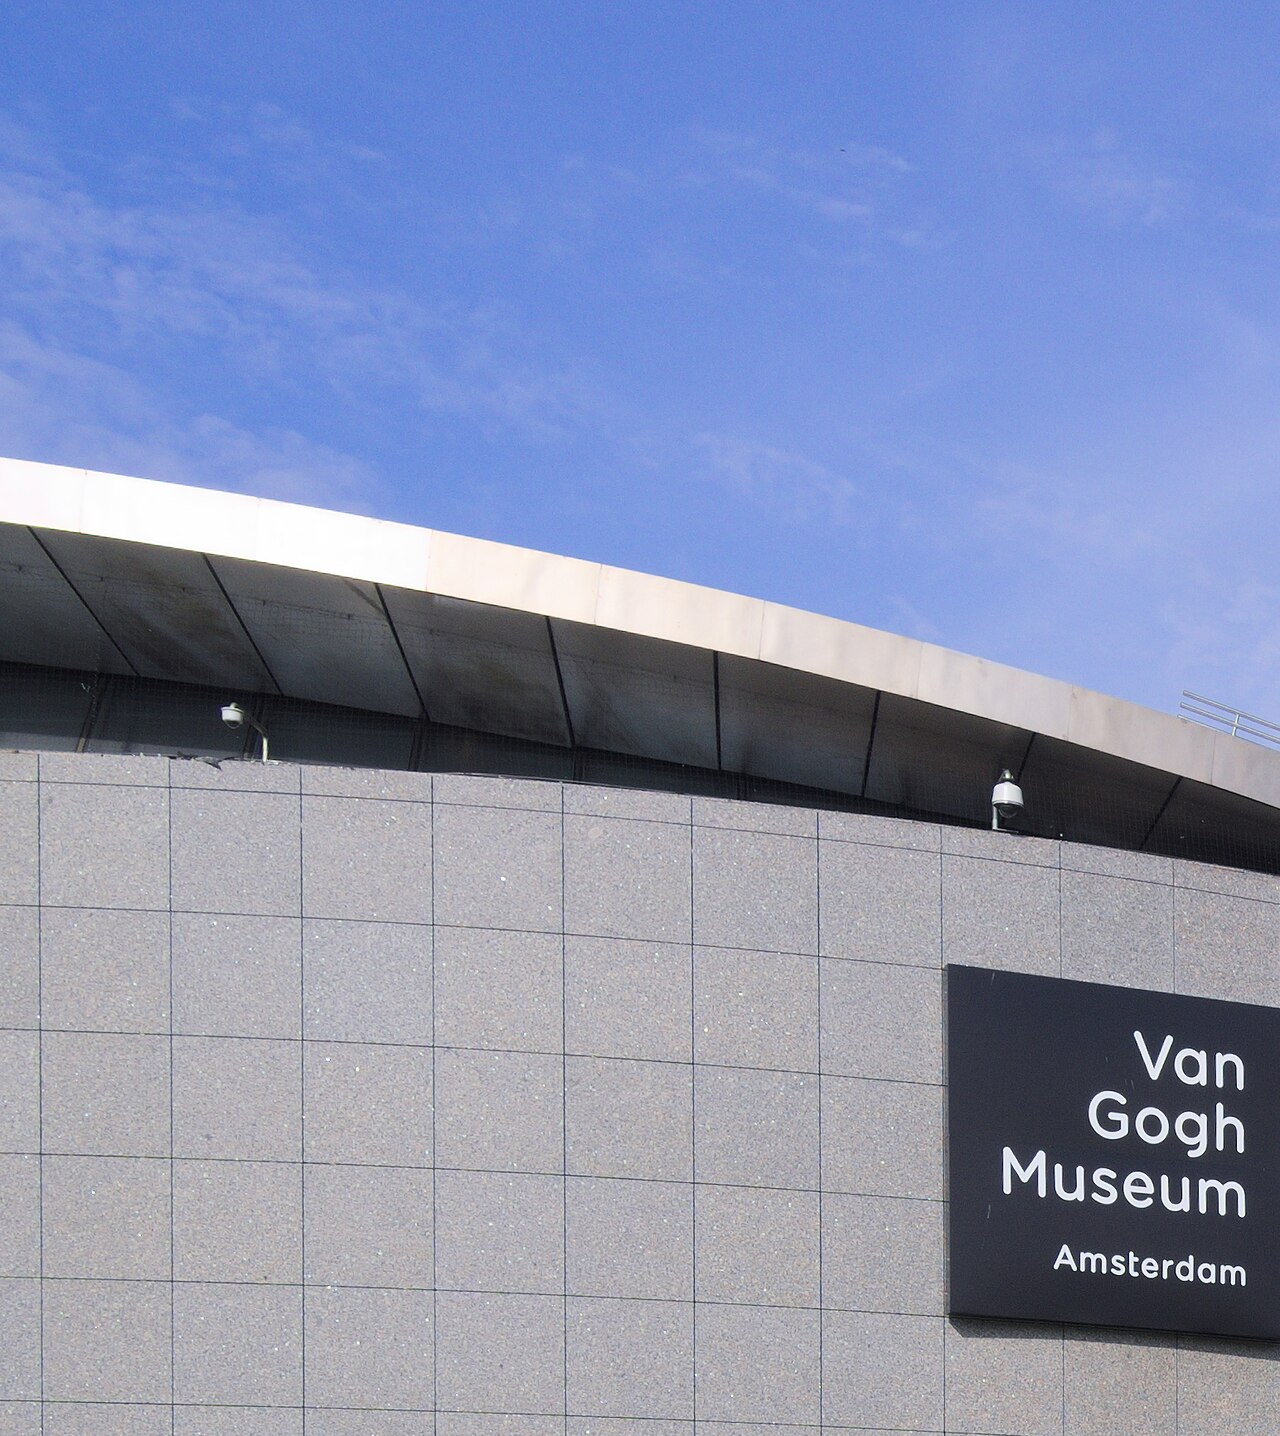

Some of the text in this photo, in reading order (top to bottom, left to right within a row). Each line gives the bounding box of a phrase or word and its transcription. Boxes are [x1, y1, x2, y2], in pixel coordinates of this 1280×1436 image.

[1133, 1030, 1245, 1091] Van
[1088, 1090, 1245, 1158] Gogh
[1001, 1146, 1247, 1219] Museum
[1053, 1243, 1247, 1287] Amsterdam
